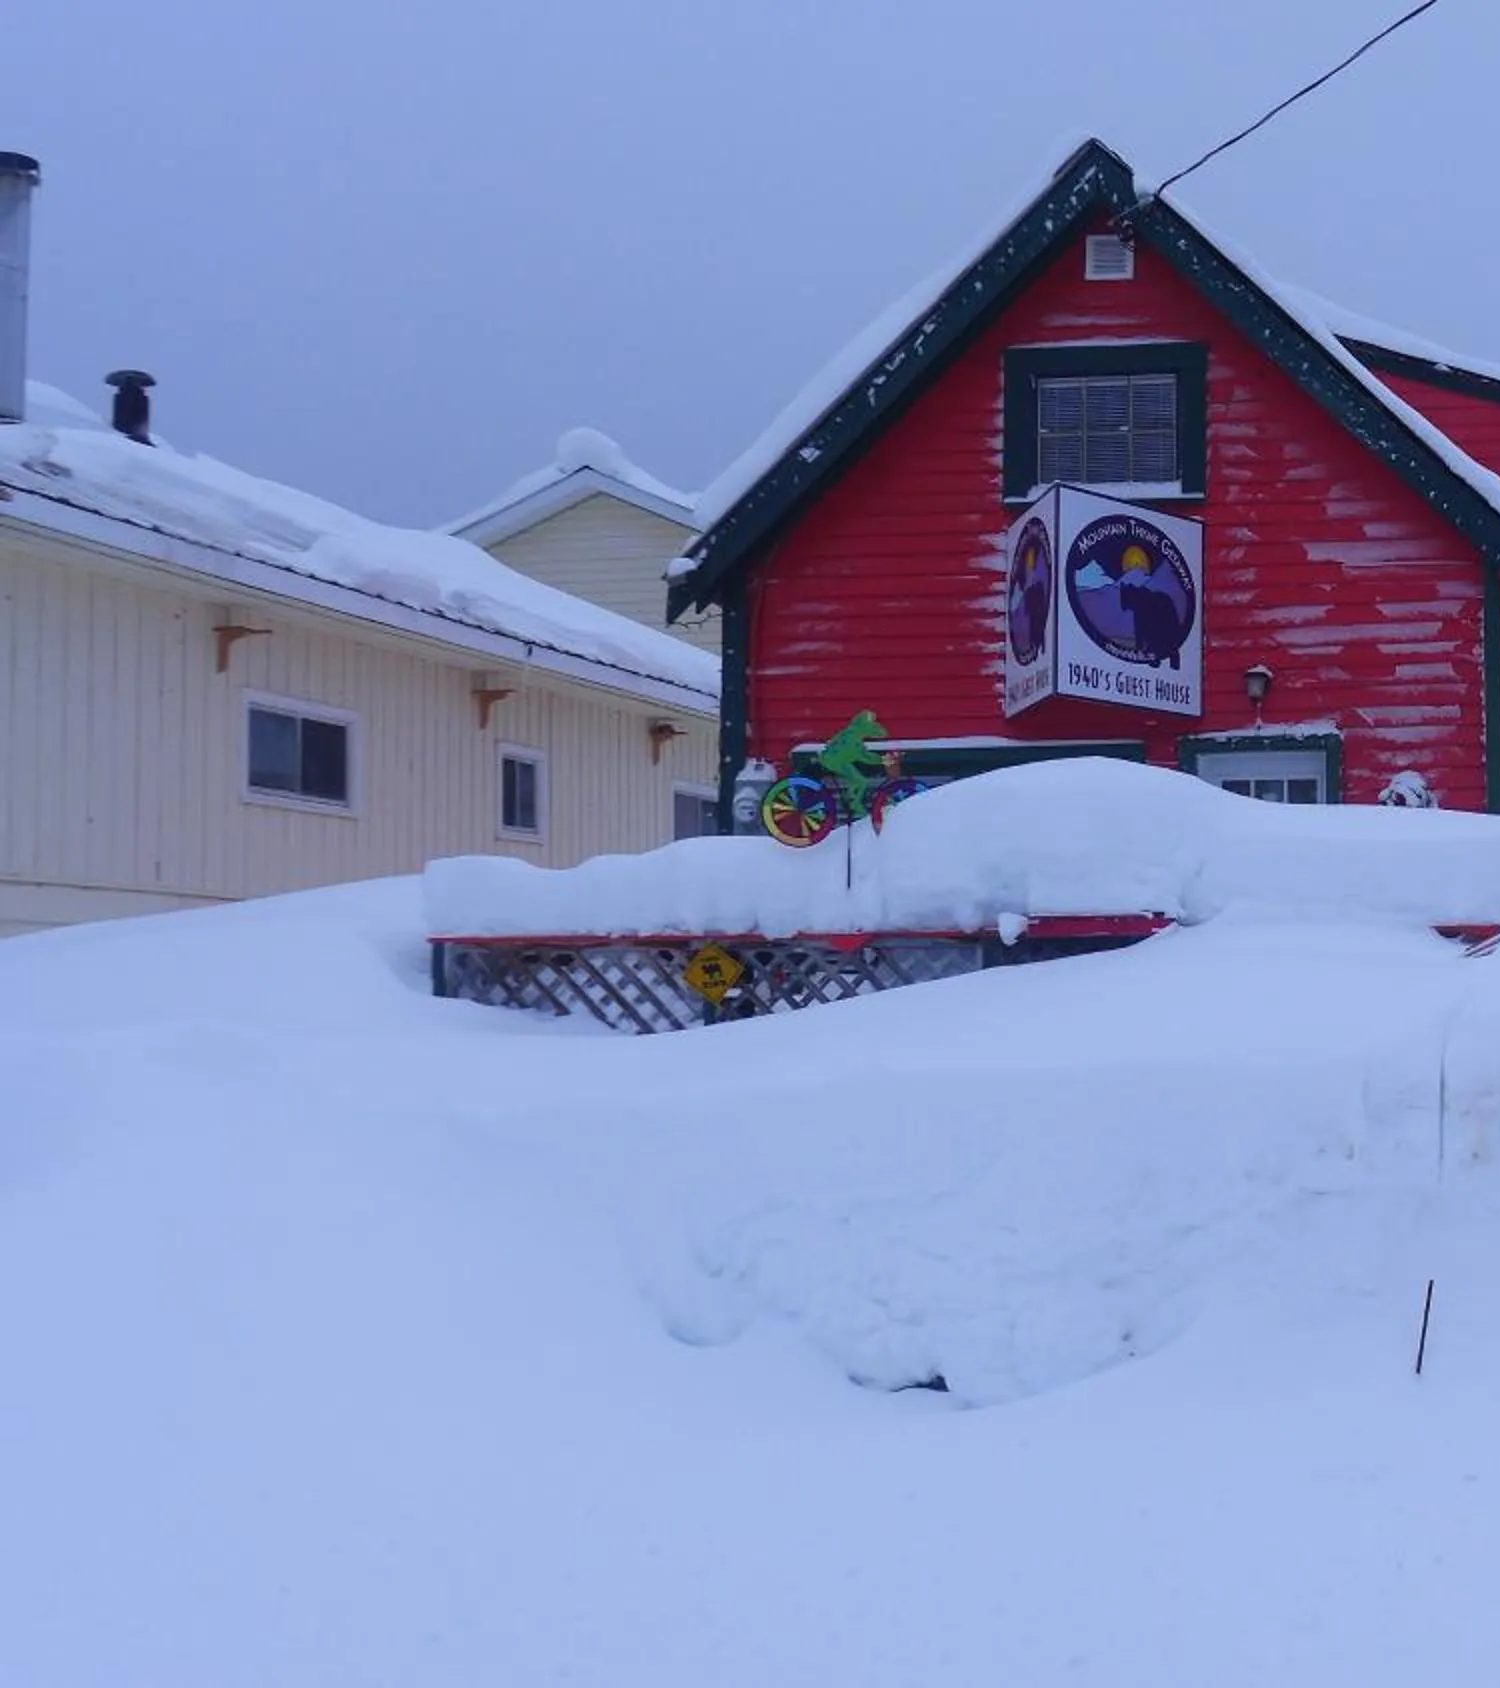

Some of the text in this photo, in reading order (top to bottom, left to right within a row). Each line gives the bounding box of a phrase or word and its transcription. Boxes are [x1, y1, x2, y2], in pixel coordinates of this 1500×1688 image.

[1068, 662, 1111, 691] 1940'S
[1115, 671, 1151, 699] GUEST
[1155, 677, 1191, 705] HOUSE
